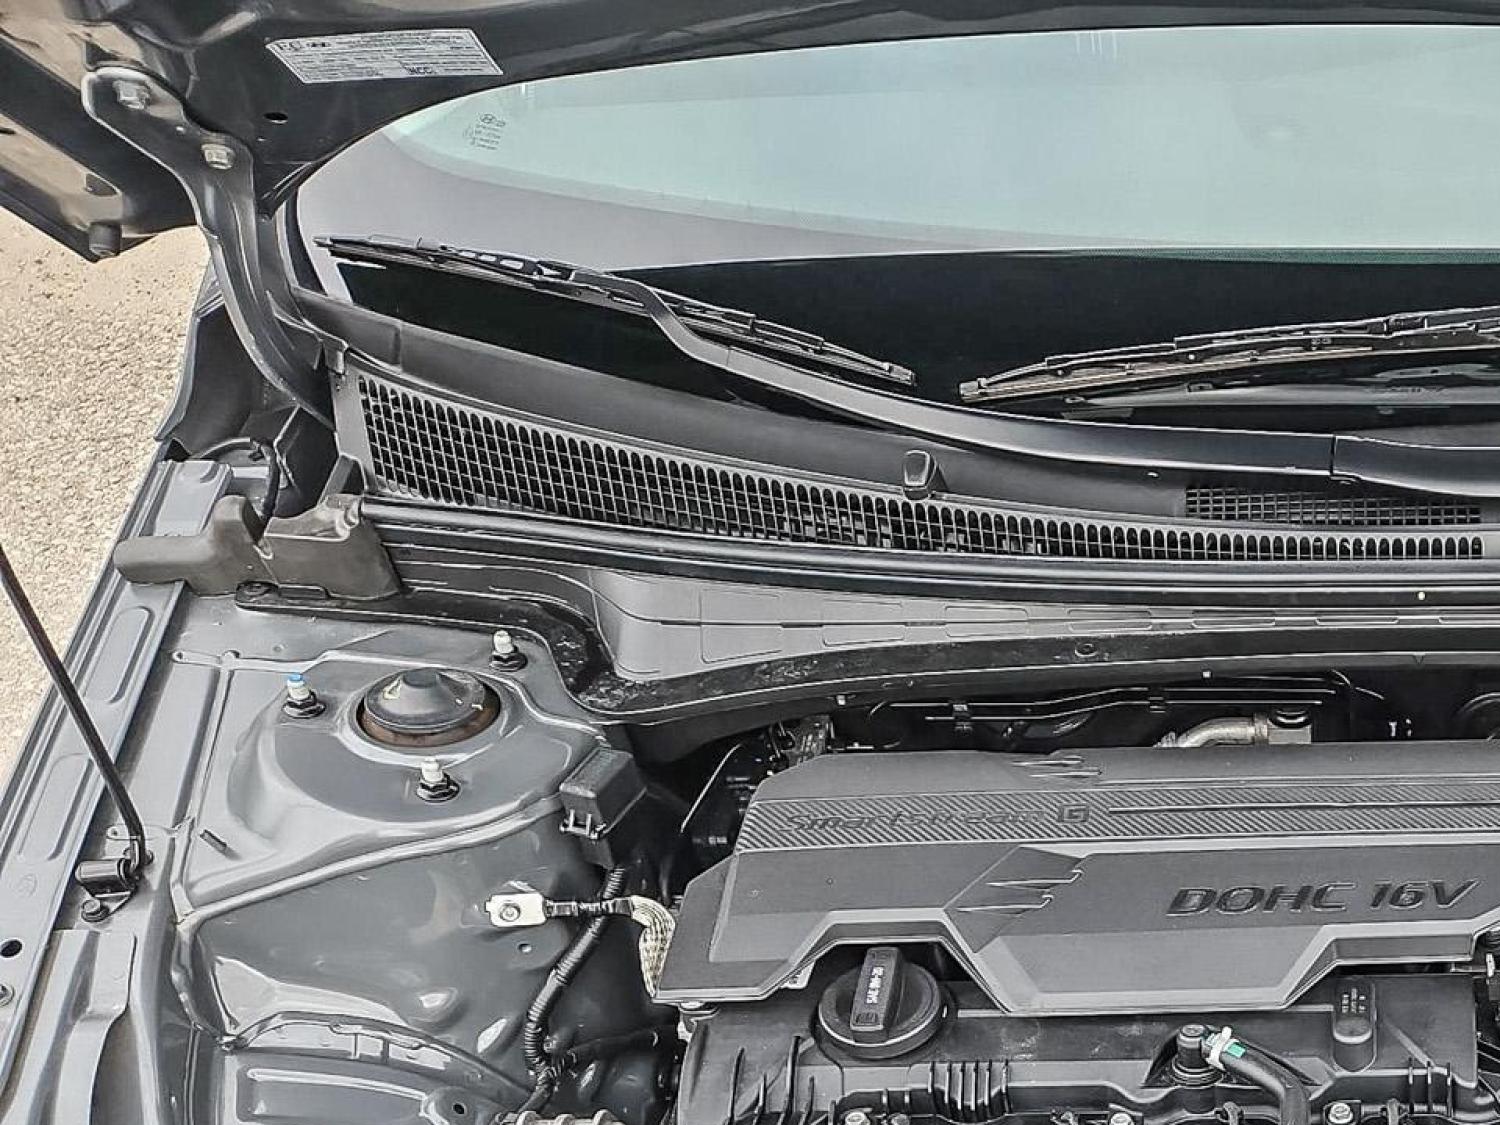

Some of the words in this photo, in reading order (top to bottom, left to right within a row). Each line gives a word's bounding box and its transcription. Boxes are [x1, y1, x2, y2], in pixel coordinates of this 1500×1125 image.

[1058, 804, 1090, 824] G
[1166, 881, 1355, 917] DOHC
[1369, 878, 1481, 911] 16V
